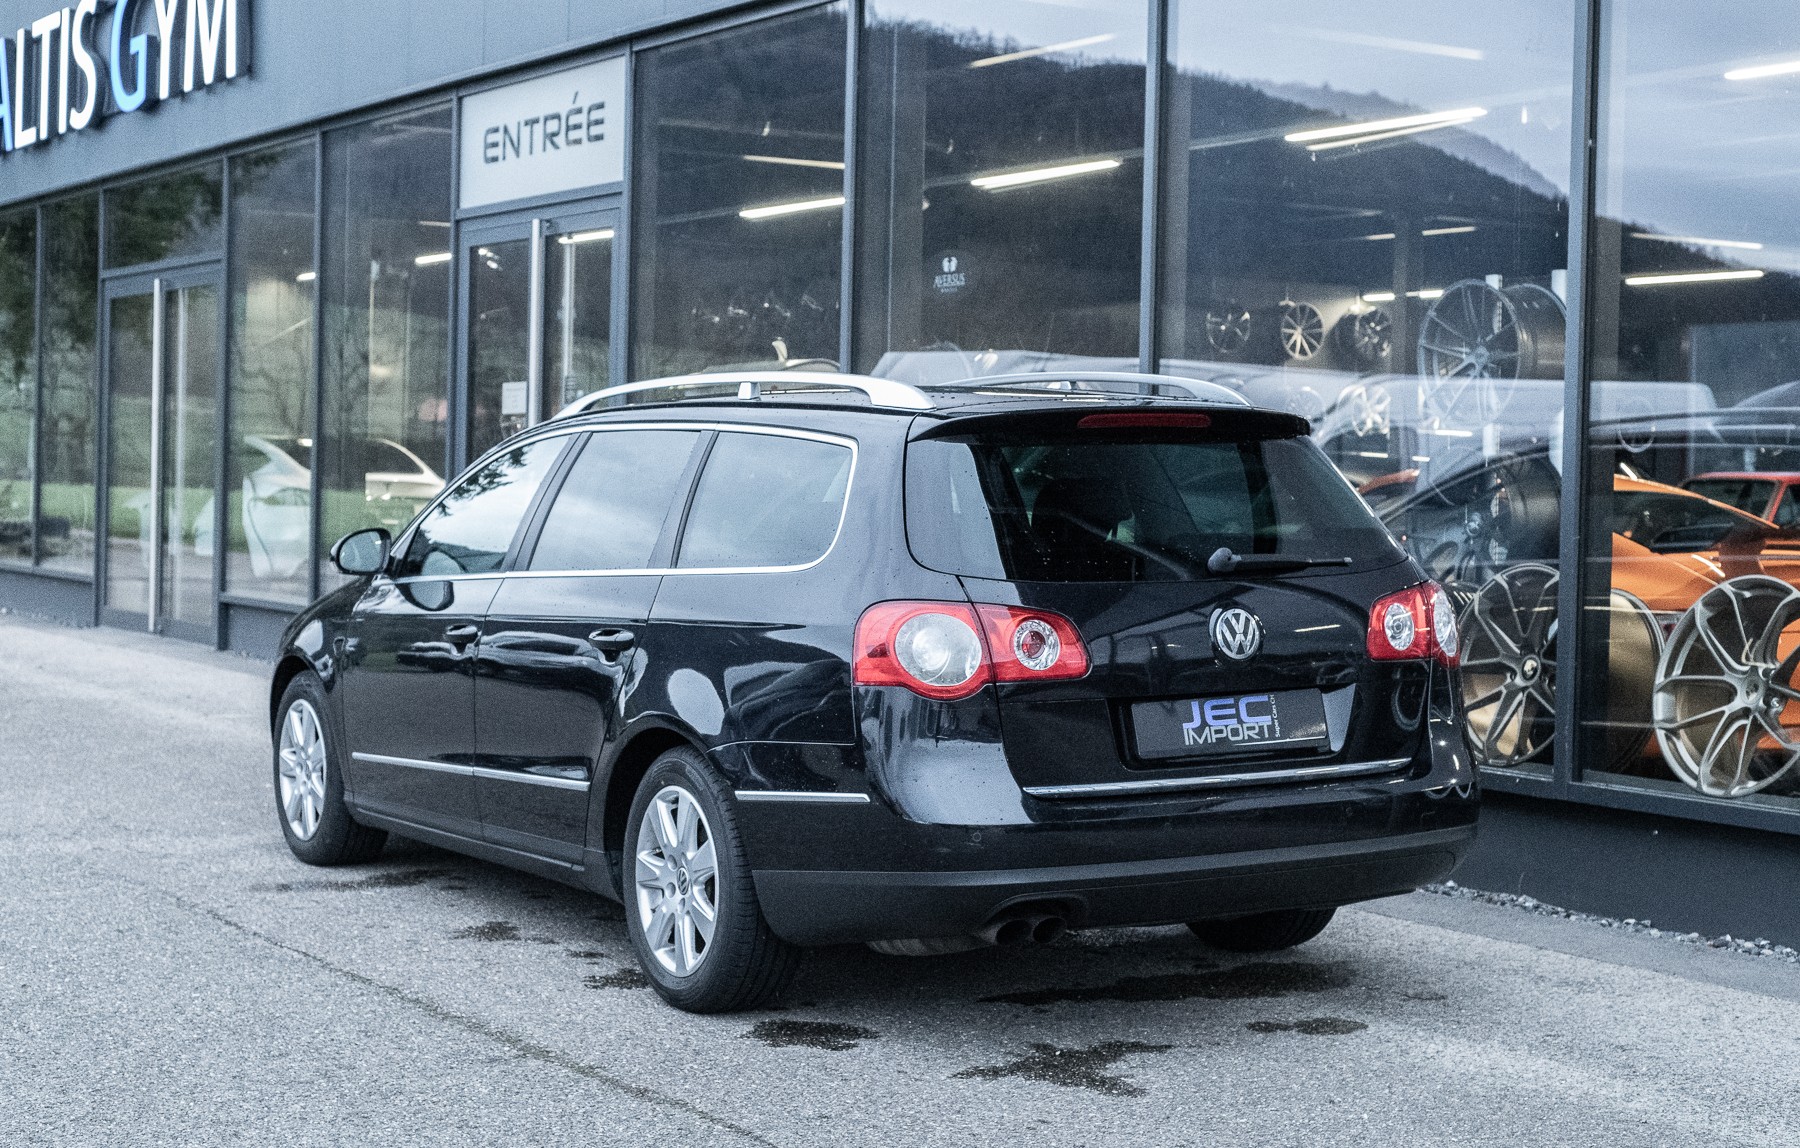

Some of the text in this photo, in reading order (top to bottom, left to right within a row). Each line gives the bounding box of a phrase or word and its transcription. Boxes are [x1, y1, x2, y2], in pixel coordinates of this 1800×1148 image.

[110, 0, 237, 112] GYM
[484, 91, 605, 164] ENTRÉE
[1182, 695, 1272, 729] JEC
[1183, 721, 1272, 745] IMPORT
